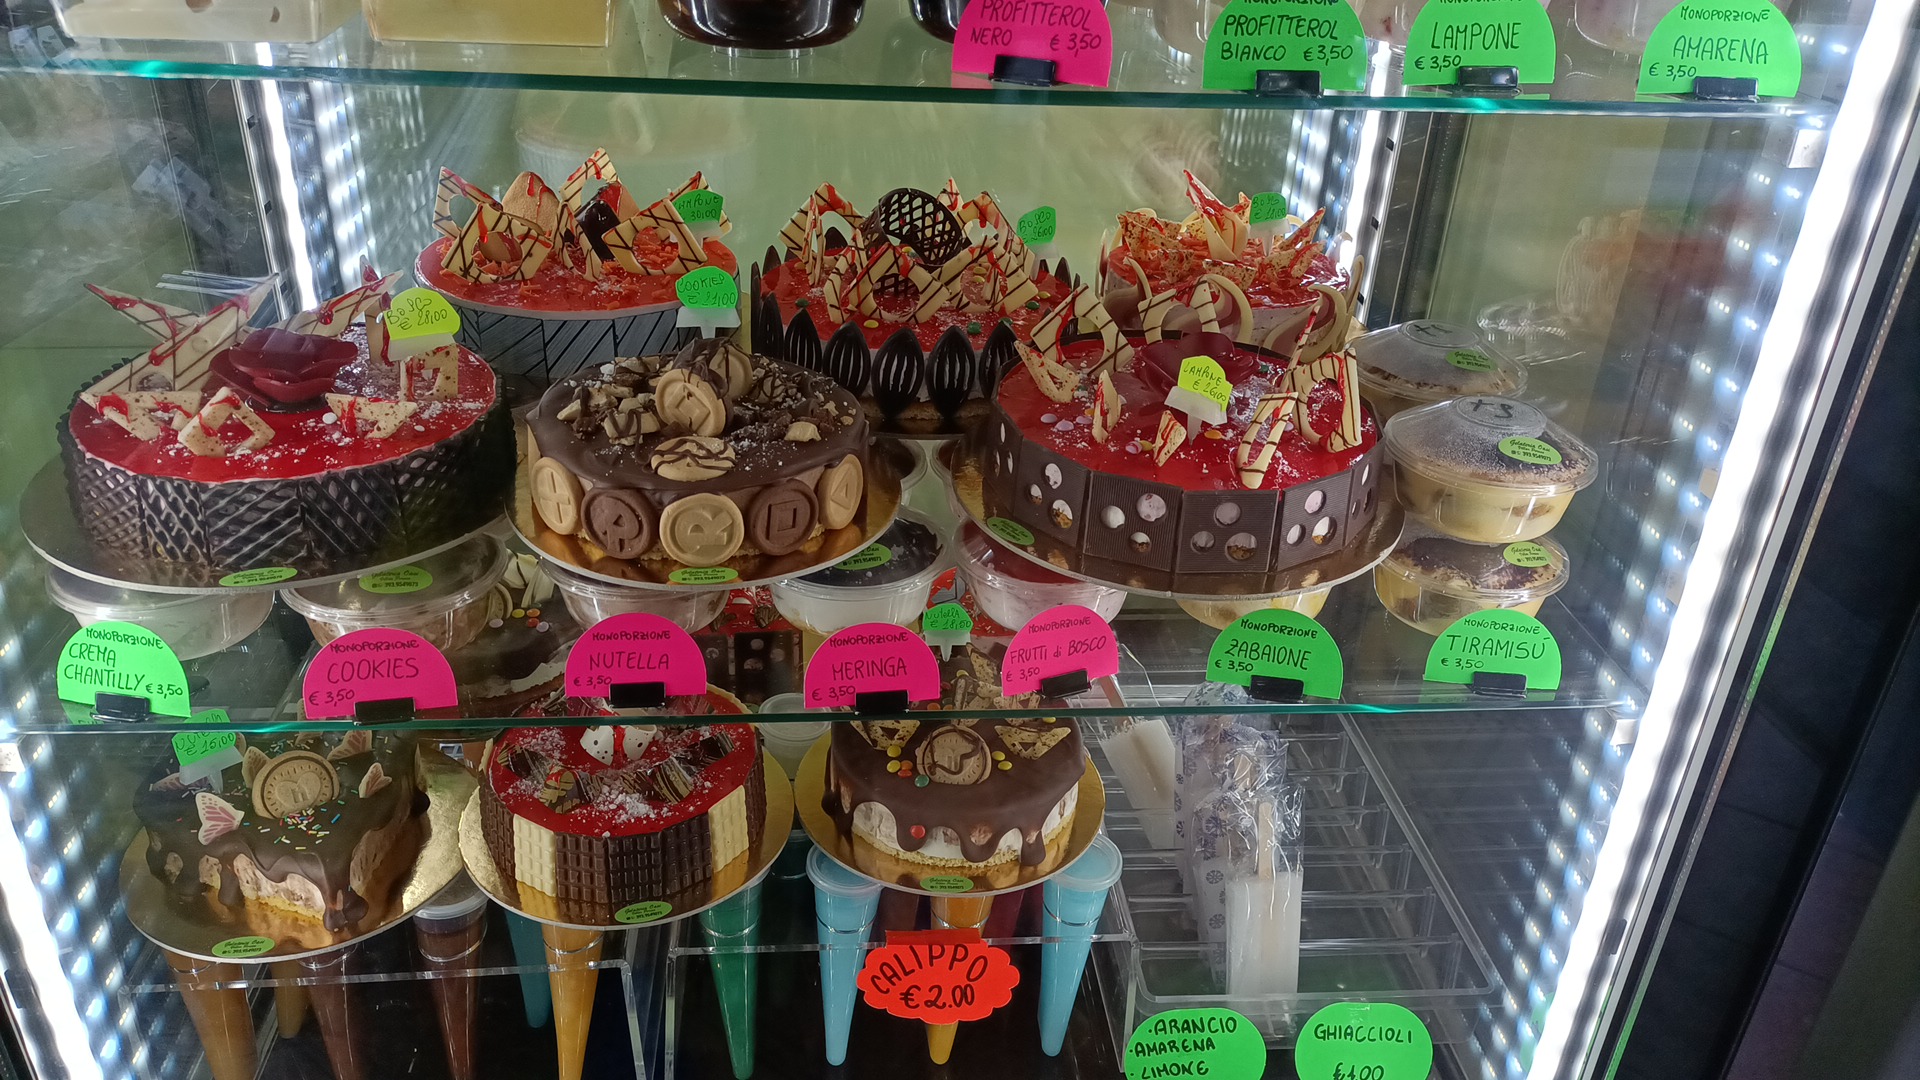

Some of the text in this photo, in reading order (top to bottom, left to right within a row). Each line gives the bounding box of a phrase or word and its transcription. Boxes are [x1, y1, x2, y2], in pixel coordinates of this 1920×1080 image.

[980, 0, 1090, 32] PROFITTEROL
[1223, 14, 1339, 40] PROFITTEROL
[1679, 8, 1771, 23] MONOPORZIONE
[970, 27, 1013, 47] NERO
[1430, 21, 1521, 51] LAMPONE
[1220, 43, 1287, 62] BIANCO
[1672, 35, 1770, 66] AMARENA
[85, 627, 164, 651] MONOPORZIONE
[1009, 634, 1108, 667] FRUTTI di BOSCO
[68, 642, 117, 668] CREMA
[588, 650, 671, 672] NUTELLA
[1223, 637, 1313, 672] ZABAIONE
[63, 663, 146, 693] CHANTILLY
[326, 657, 420, 685] COOKIES
[830, 656, 908, 683] MERINGA
[869, 944, 989, 994] CALIPPO
[1153, 1016, 1239, 1036] ARANCIO
[1313, 1022, 1415, 1046] GHIACCIOLI
[1134, 1037, 1217, 1058] AMARENA
[1142, 1060, 1210, 1080] LIMONE
